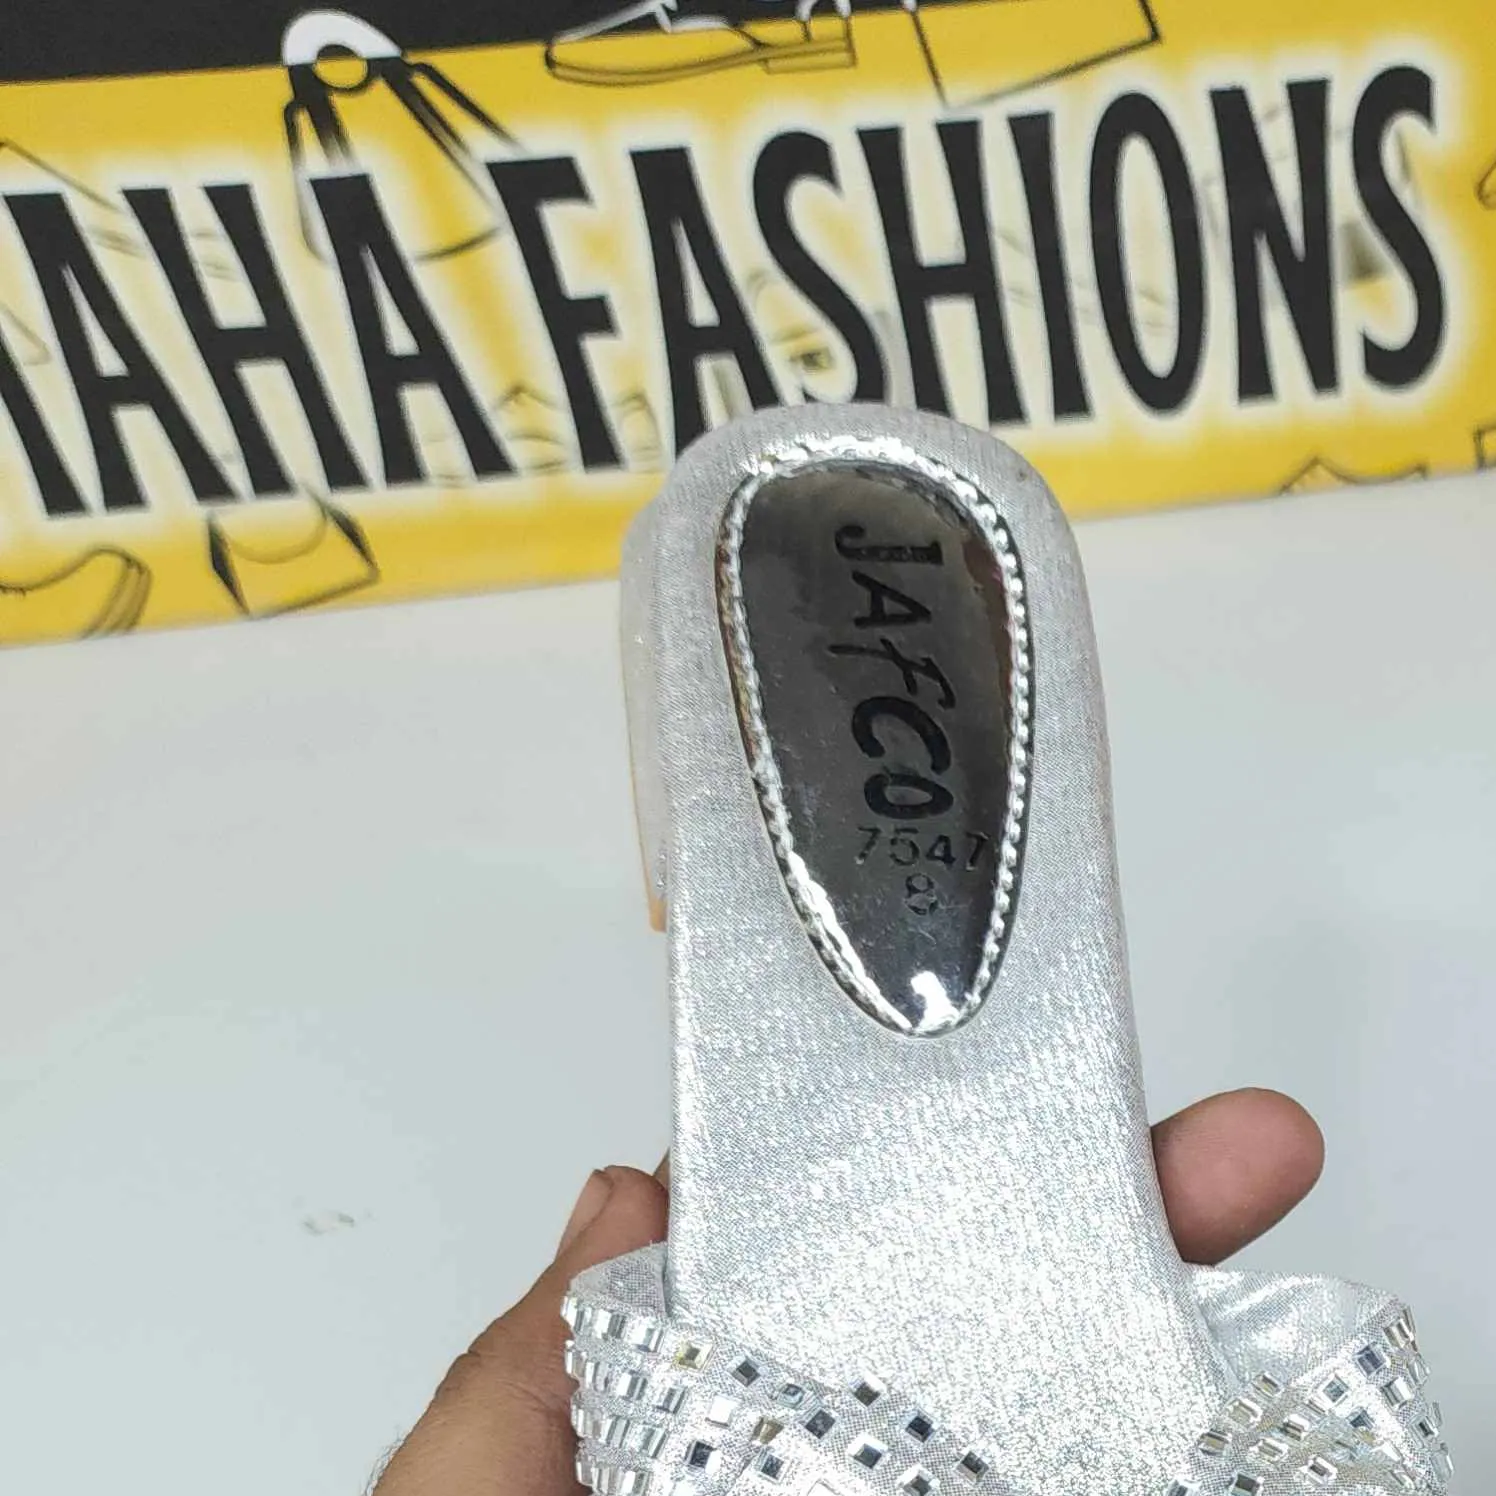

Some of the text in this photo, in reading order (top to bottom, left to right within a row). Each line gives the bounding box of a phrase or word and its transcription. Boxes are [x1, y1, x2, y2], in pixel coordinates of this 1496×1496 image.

[485, 64, 1446, 473] FASHIONS
[856, 826, 992, 872] 7547
[904, 873, 940, 916] 8
